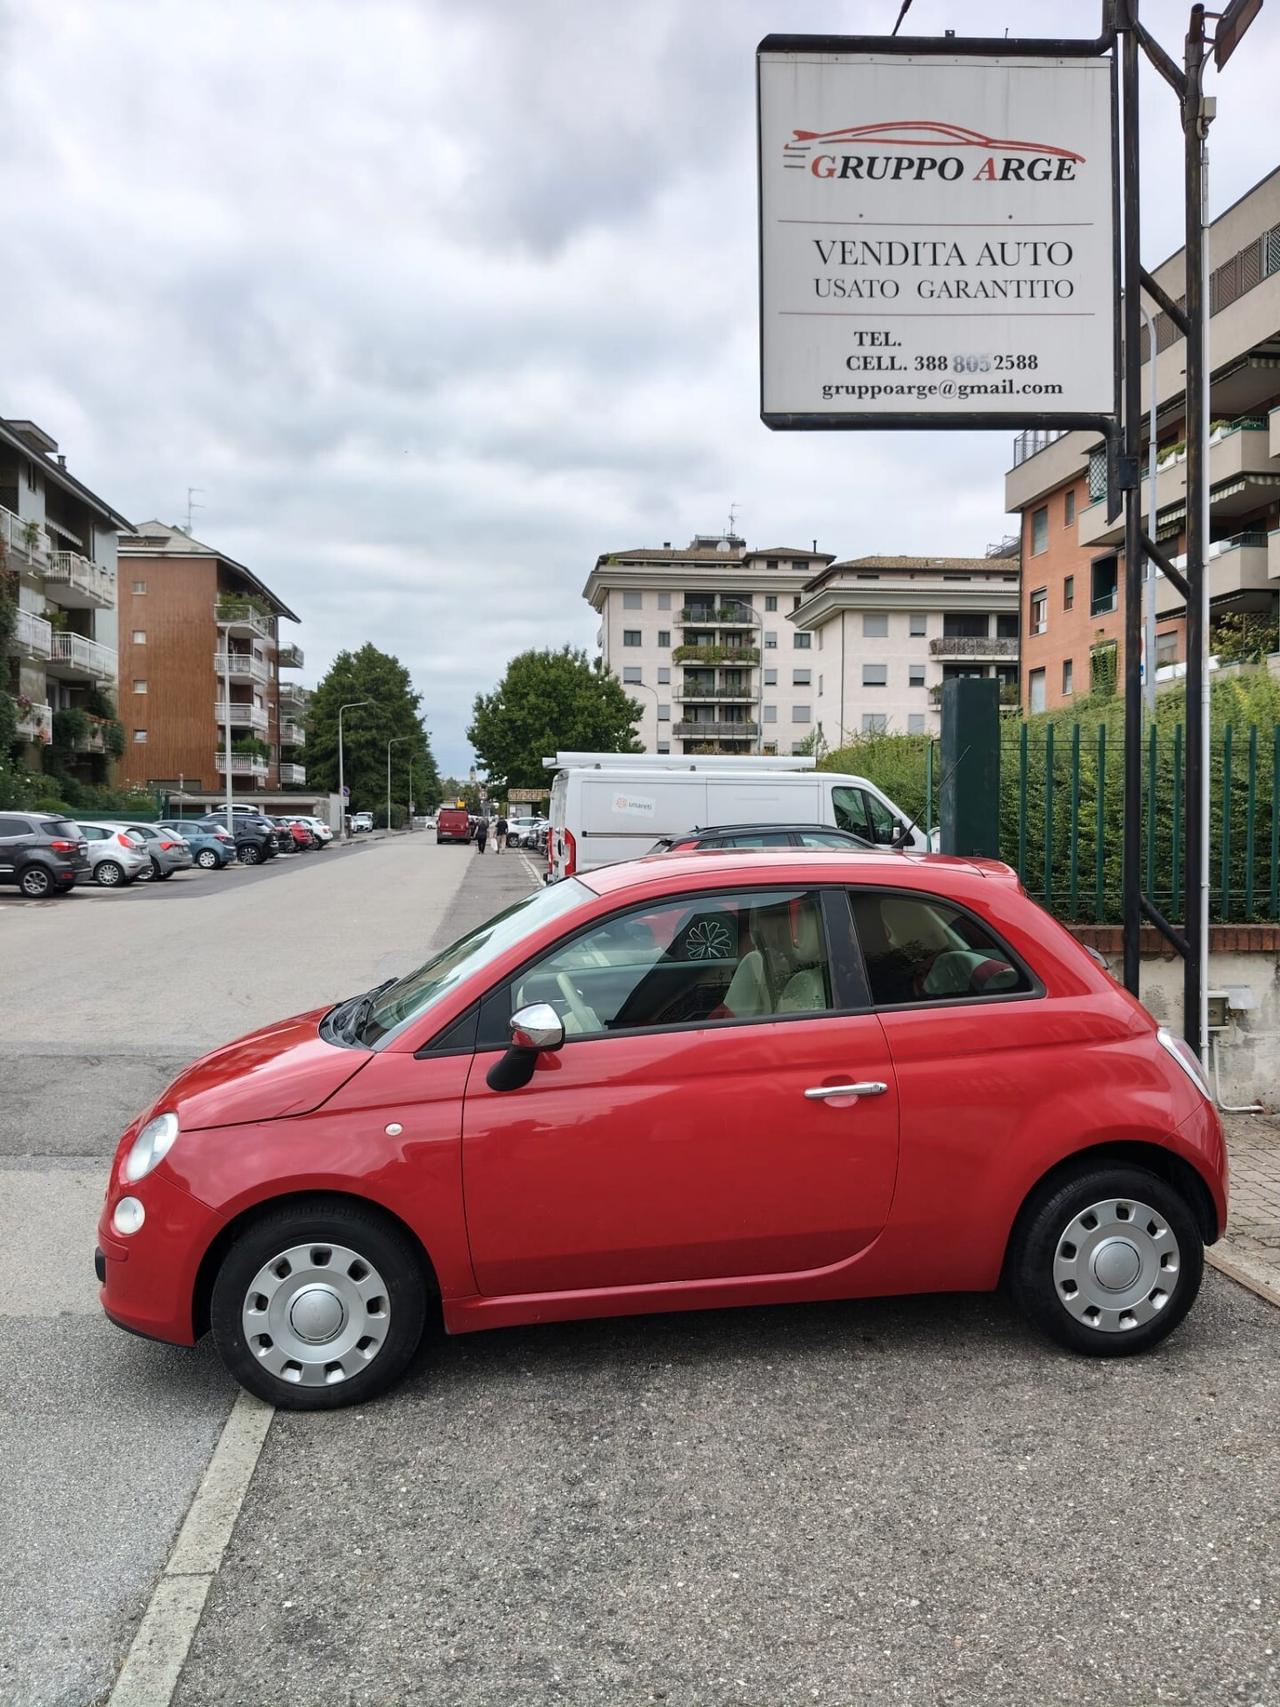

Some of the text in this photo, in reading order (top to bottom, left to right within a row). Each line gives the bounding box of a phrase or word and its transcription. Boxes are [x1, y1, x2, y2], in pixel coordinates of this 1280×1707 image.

[811, 155, 1077, 181] GRUPPO ARGE
[813, 240, 1073, 267] VENDITA AUTO
[814, 278, 1074, 299] USATO GARANTITO
[854, 331, 902, 347] TEL.
[846, 355, 907, 371] CELL.
[914, 355, 948, 371] 388
[994, 354, 1038, 370] 2588
[822, 379, 1063, 400] gruppoarge@gmail.com
